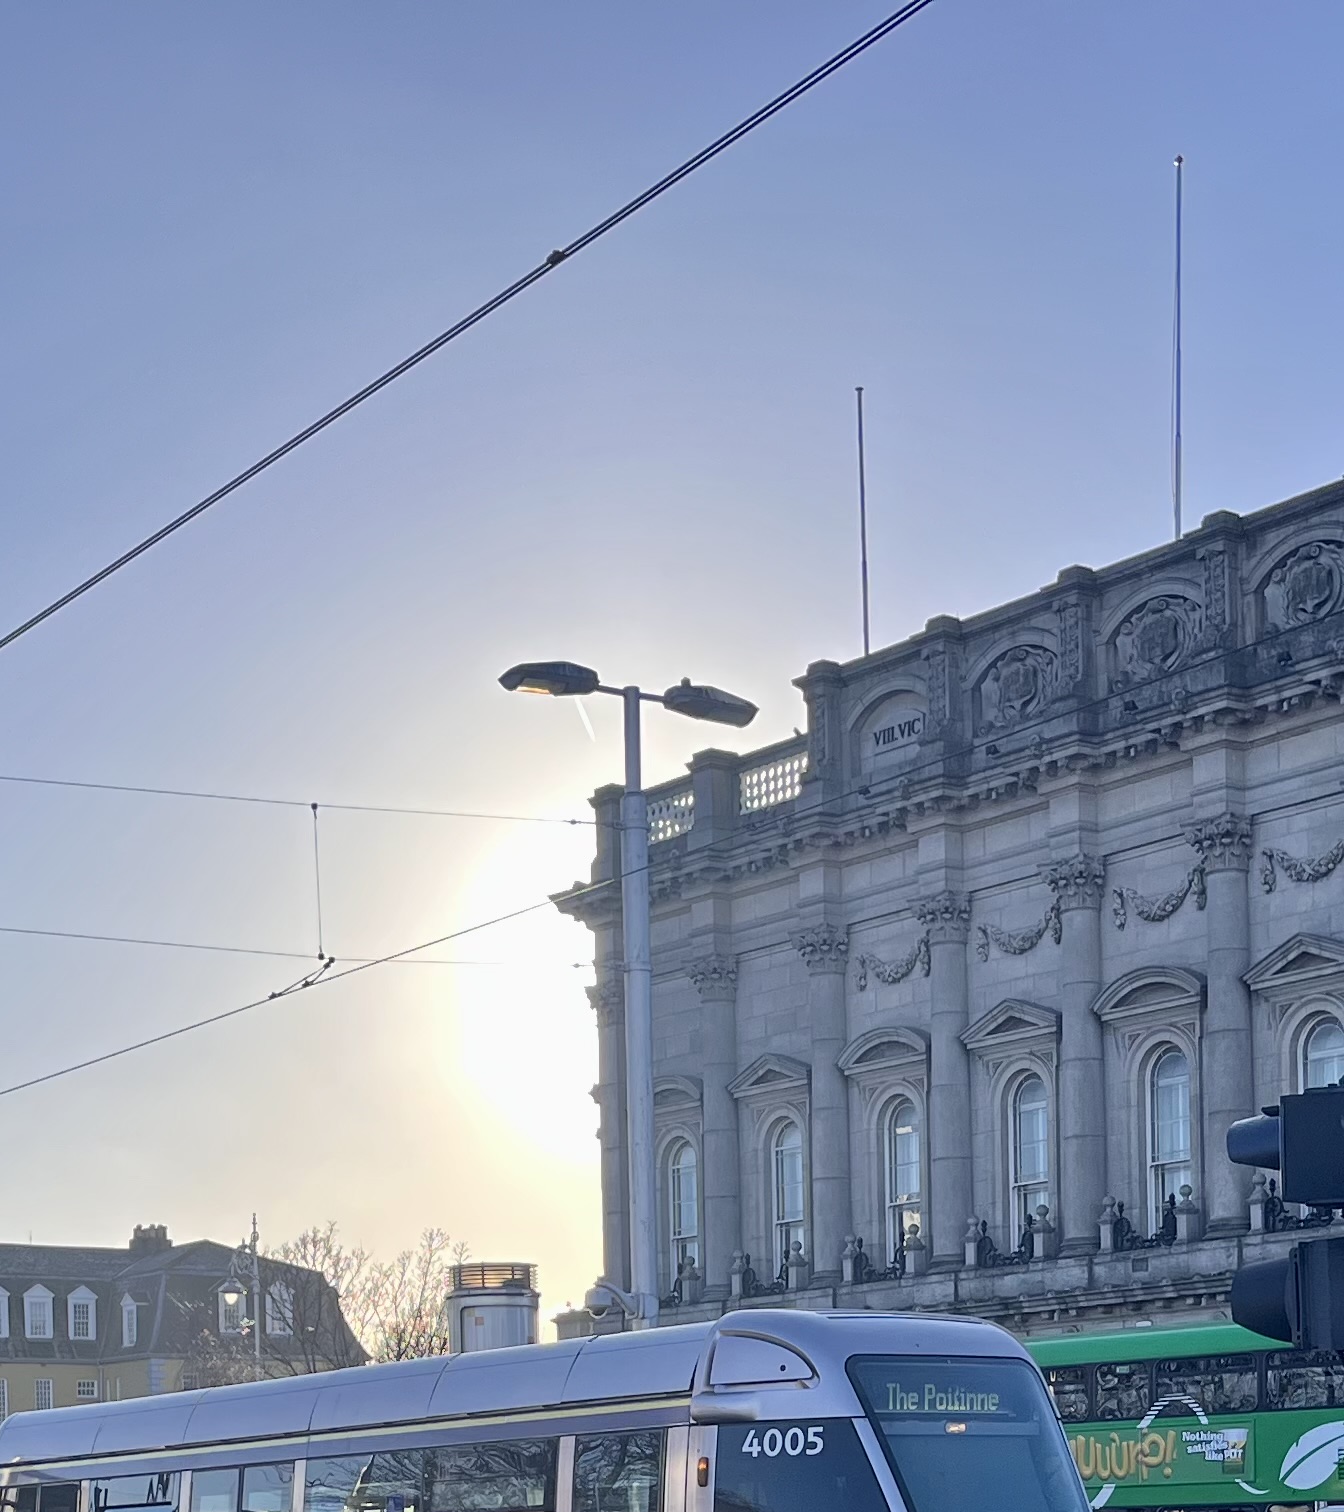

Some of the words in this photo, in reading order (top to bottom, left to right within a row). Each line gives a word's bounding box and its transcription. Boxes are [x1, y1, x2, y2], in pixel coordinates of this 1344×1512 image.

[886, 1383, 918, 1410] The
[742, 1426, 824, 1458] 4005
[1182, 1430, 1224, 1442] Nothing
[1205, 1450, 1224, 1461] like
